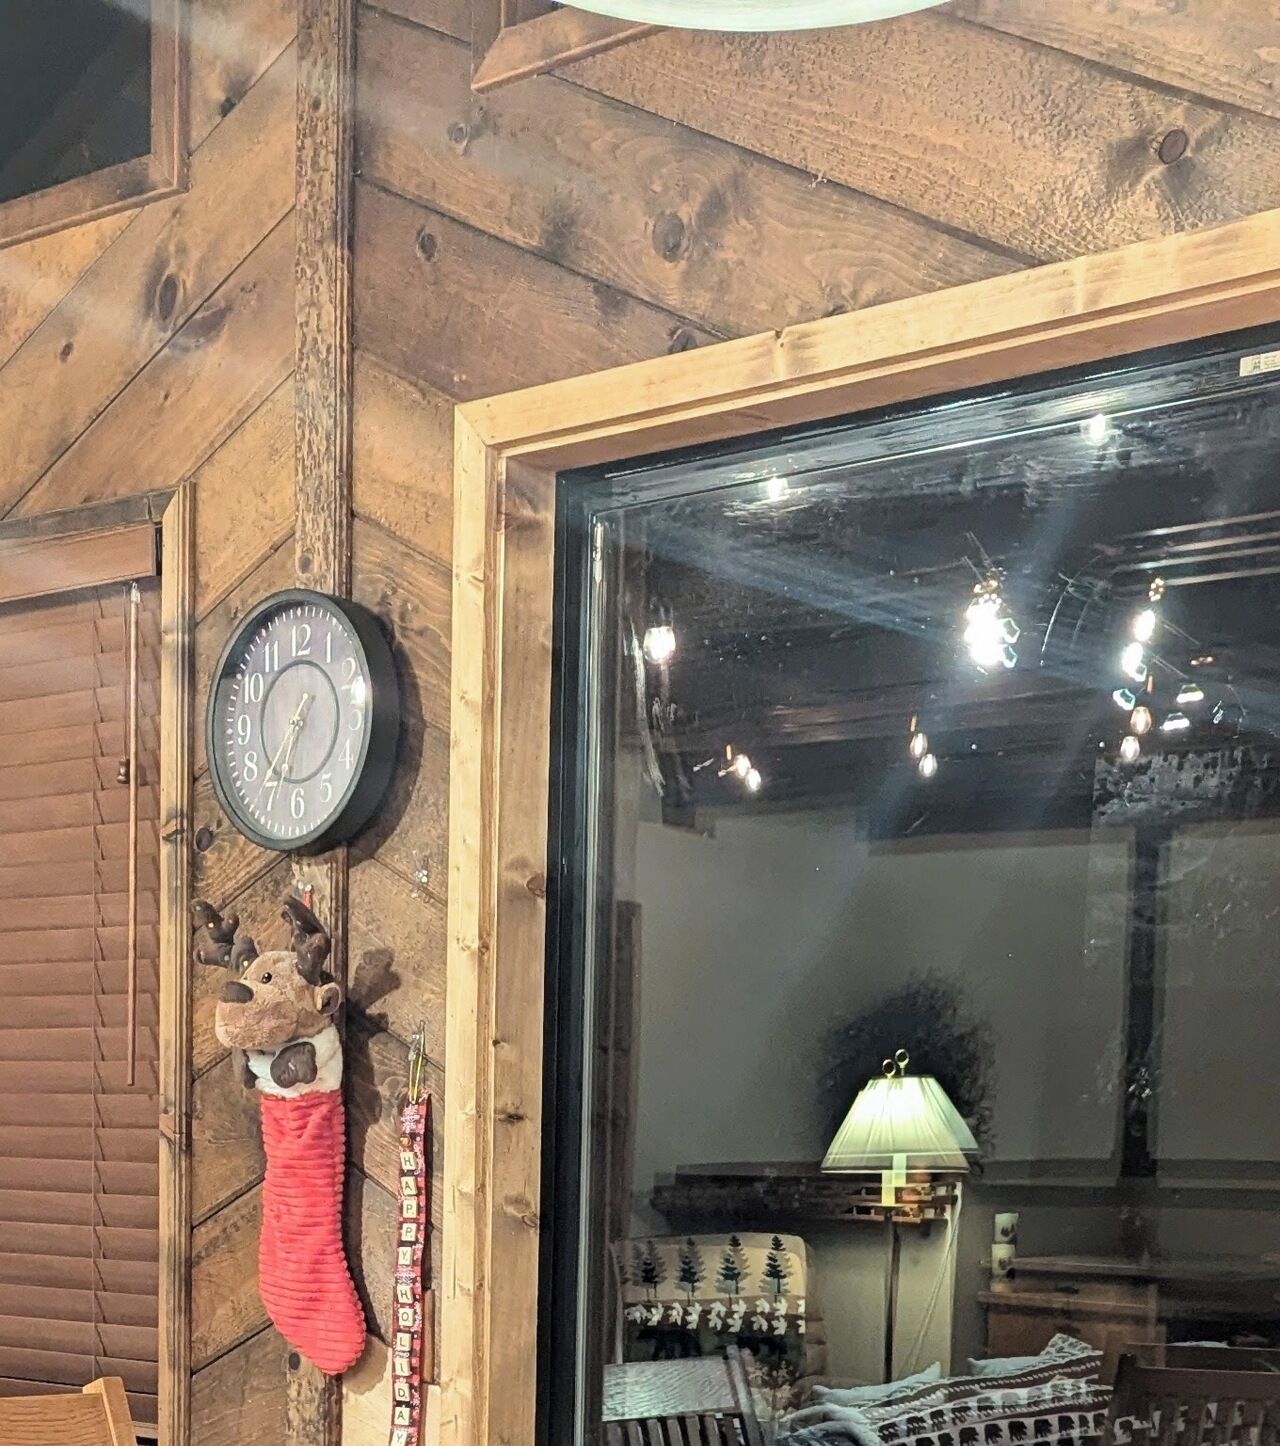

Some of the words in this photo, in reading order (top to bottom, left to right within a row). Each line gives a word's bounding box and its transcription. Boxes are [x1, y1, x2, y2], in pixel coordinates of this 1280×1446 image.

[291, 623, 311, 657] 12
[326, 631, 332, 664] 1
[264, 640, 279, 673] 11
[244, 672, 264, 704] 10
[341, 657, 357, 690] 2
[237, 714, 251, 745] 9
[243, 751, 258, 782] 8
[338, 738, 354, 771] 4
[265, 781, 278, 812] 7
[290, 787, 305, 819] 6
[319, 772, 332, 803] 5
[400, 1154, 416, 1263] HAPPY
